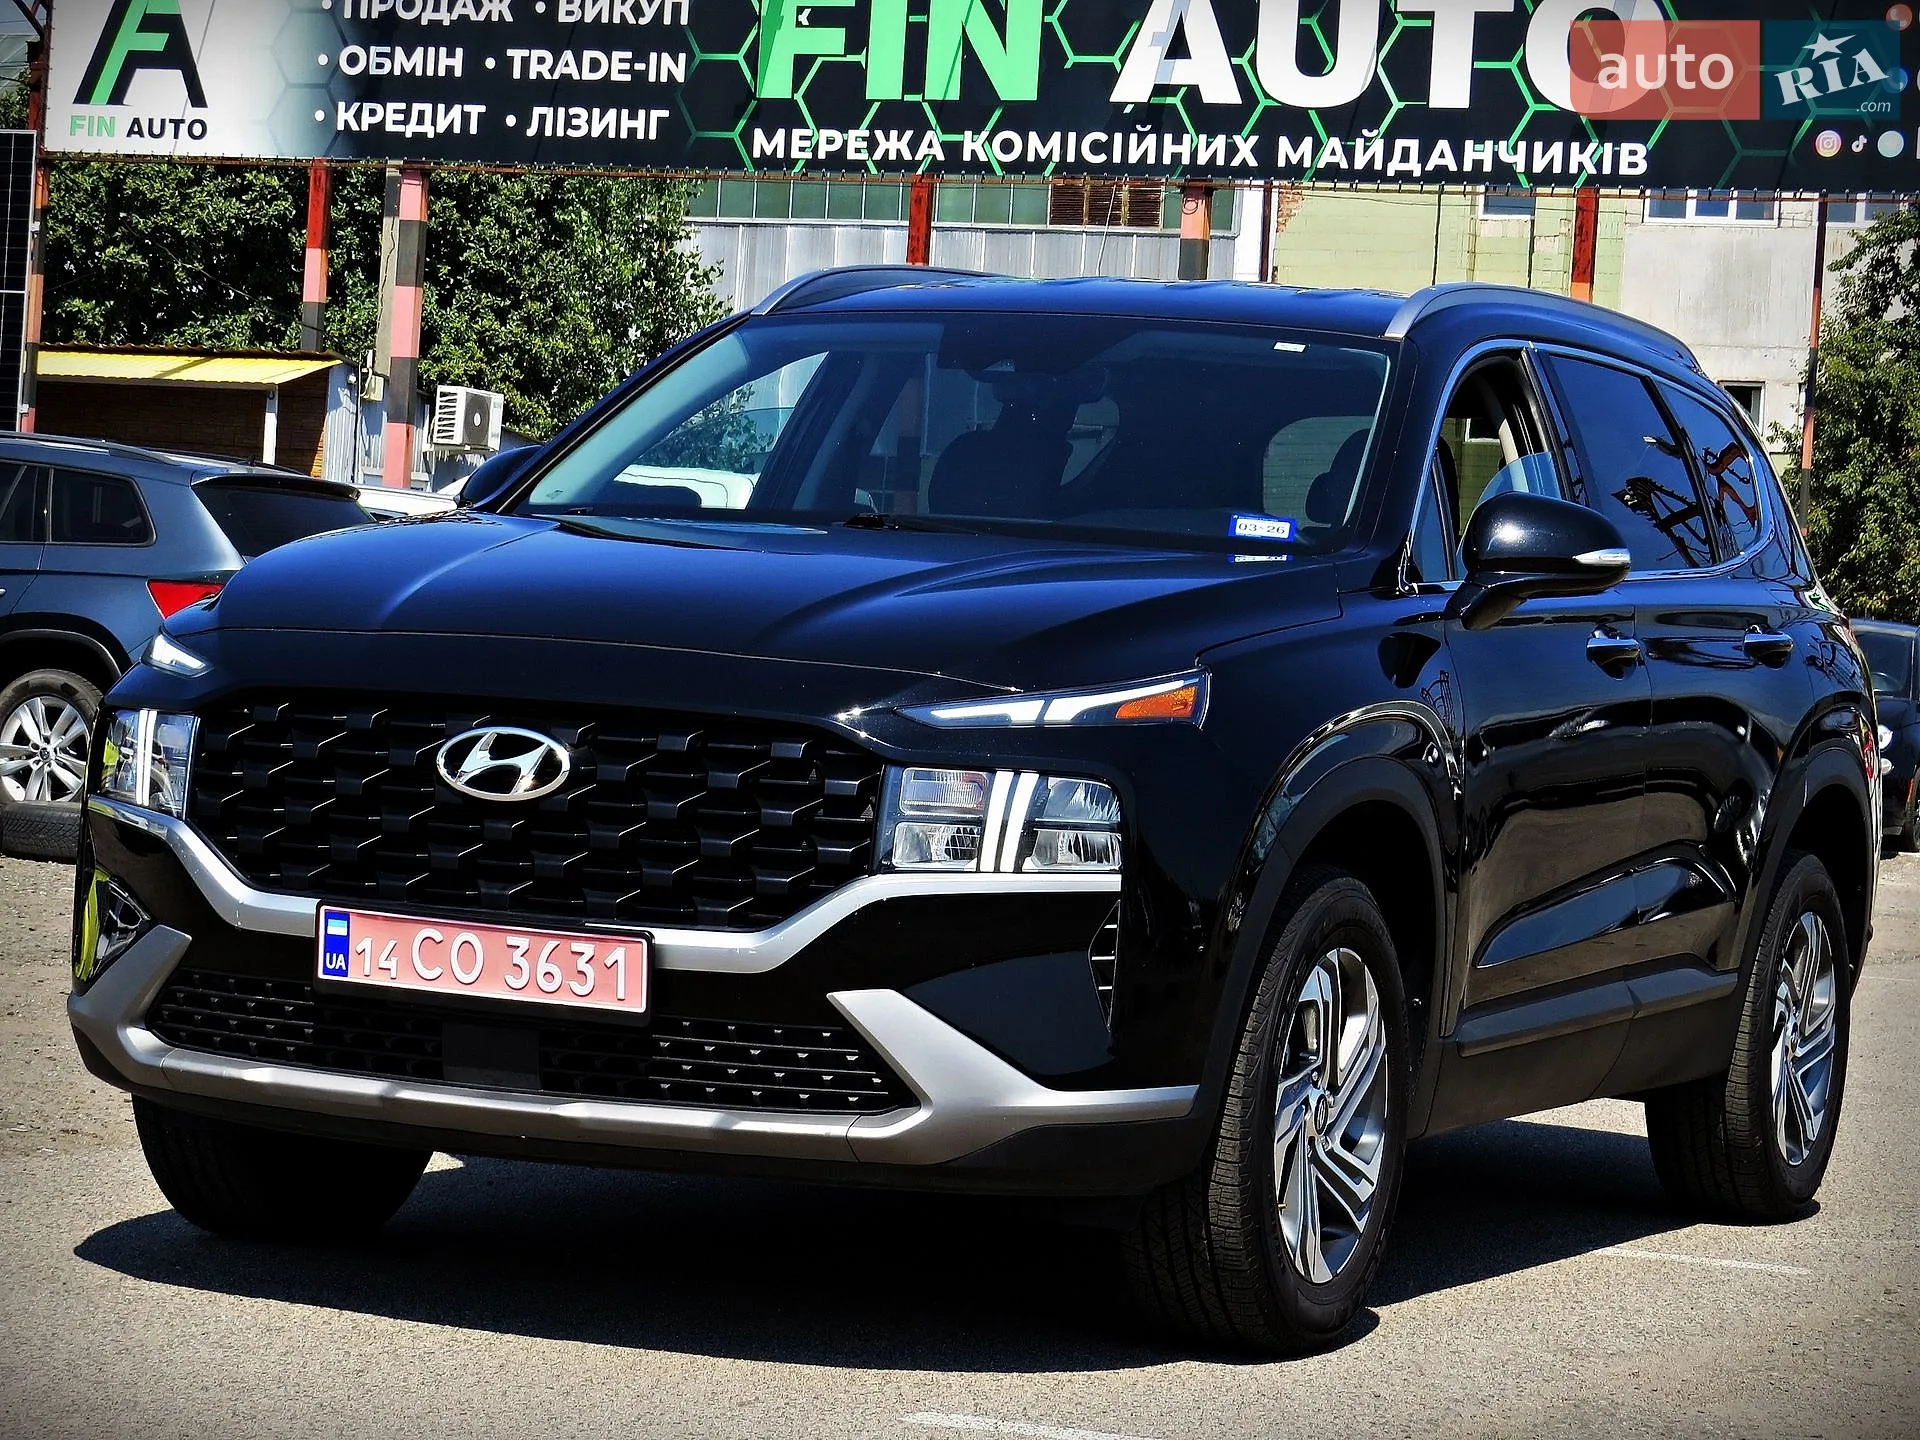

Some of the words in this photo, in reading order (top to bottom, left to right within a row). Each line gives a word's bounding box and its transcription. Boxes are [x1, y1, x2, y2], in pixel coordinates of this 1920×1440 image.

[343, 0, 514, 26] ПРОДАЖ
[557, 0, 689, 26] ВИКУП
[338, 45, 464, 77] ОБМІН
[505, 48, 687, 84] TRADE-IN
[756, 0, 1043, 101] FIN
[1109, 0, 1669, 112] AUTO
[69, 114, 116, 138] FIN
[125, 117, 208, 141] AUTO
[336, 102, 487, 136] КРЕДИТ
[525, 107, 670, 141] ЛІЗИНГ
[752, 127, 945, 162] МЕРЕЖА
[962, 124, 1259, 168] КОМІСІЙНИХ
[1276, 128, 1650, 177] МАЙДАНЧИКІВ
[326, 953, 346, 971] UA
[355, 936, 398, 979] 14
[504, 935, 627, 1001] 3631
